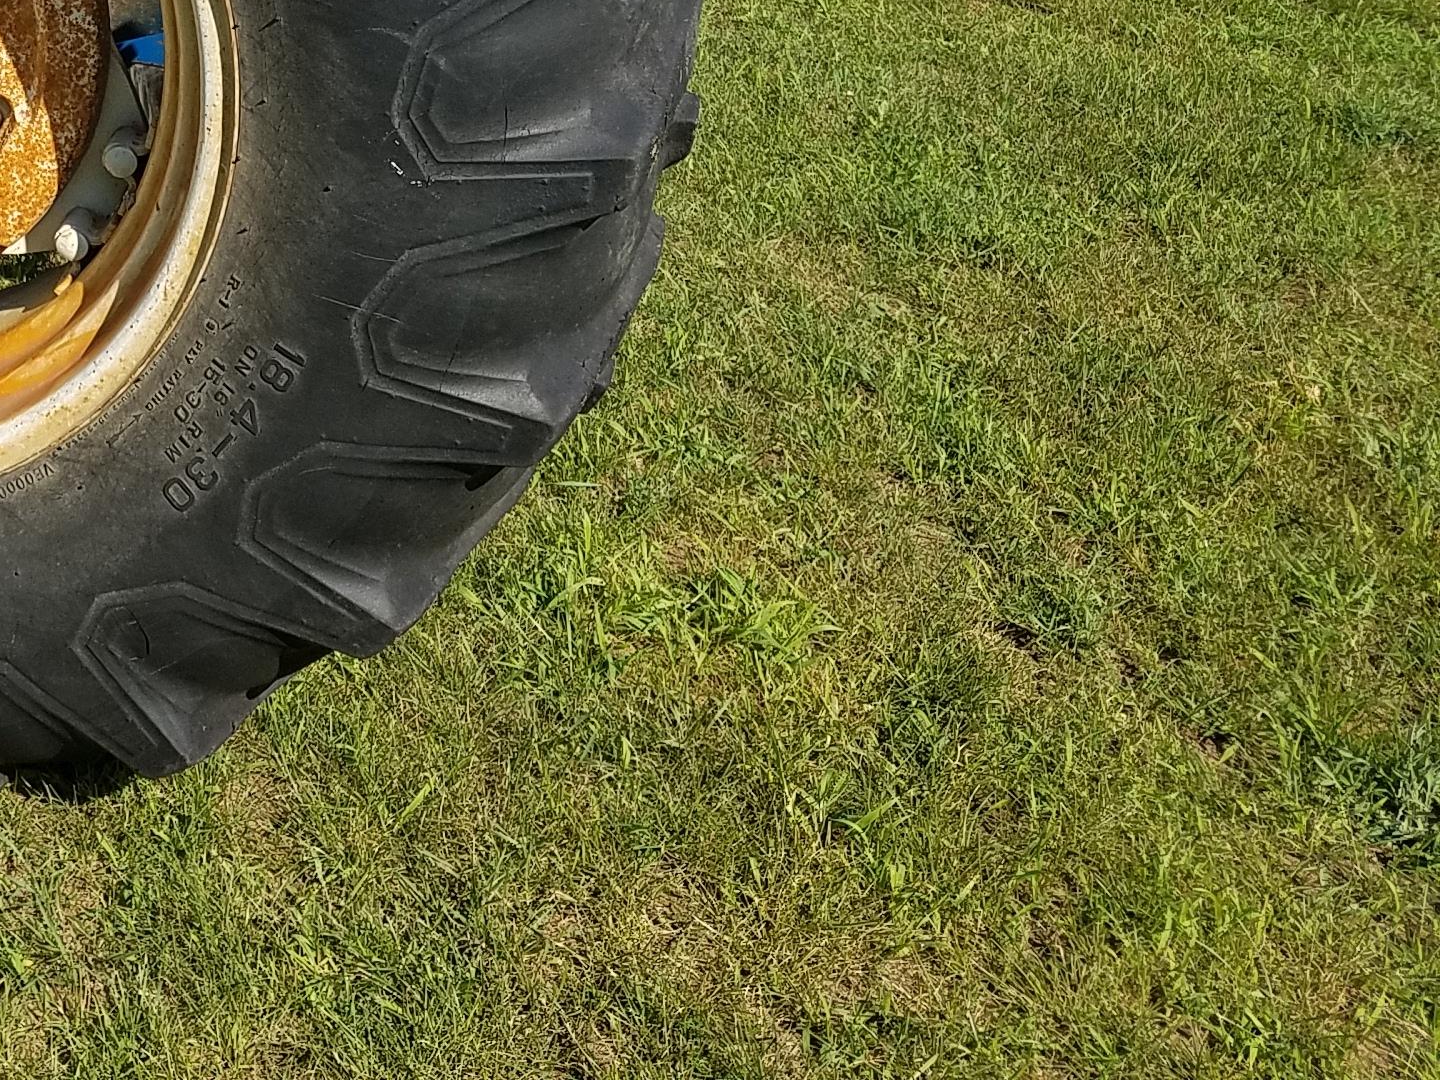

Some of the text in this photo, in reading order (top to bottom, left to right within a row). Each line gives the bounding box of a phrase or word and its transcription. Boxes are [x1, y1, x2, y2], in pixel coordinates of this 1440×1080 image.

[183, 338, 206, 368] PLY
[234, 343, 259, 379] ON
[145, 365, 184, 412] RATING
[171, 354, 227, 422] 15-30
[161, 341, 308, 513] 18.4-30
[164, 420, 204, 464] RIM
